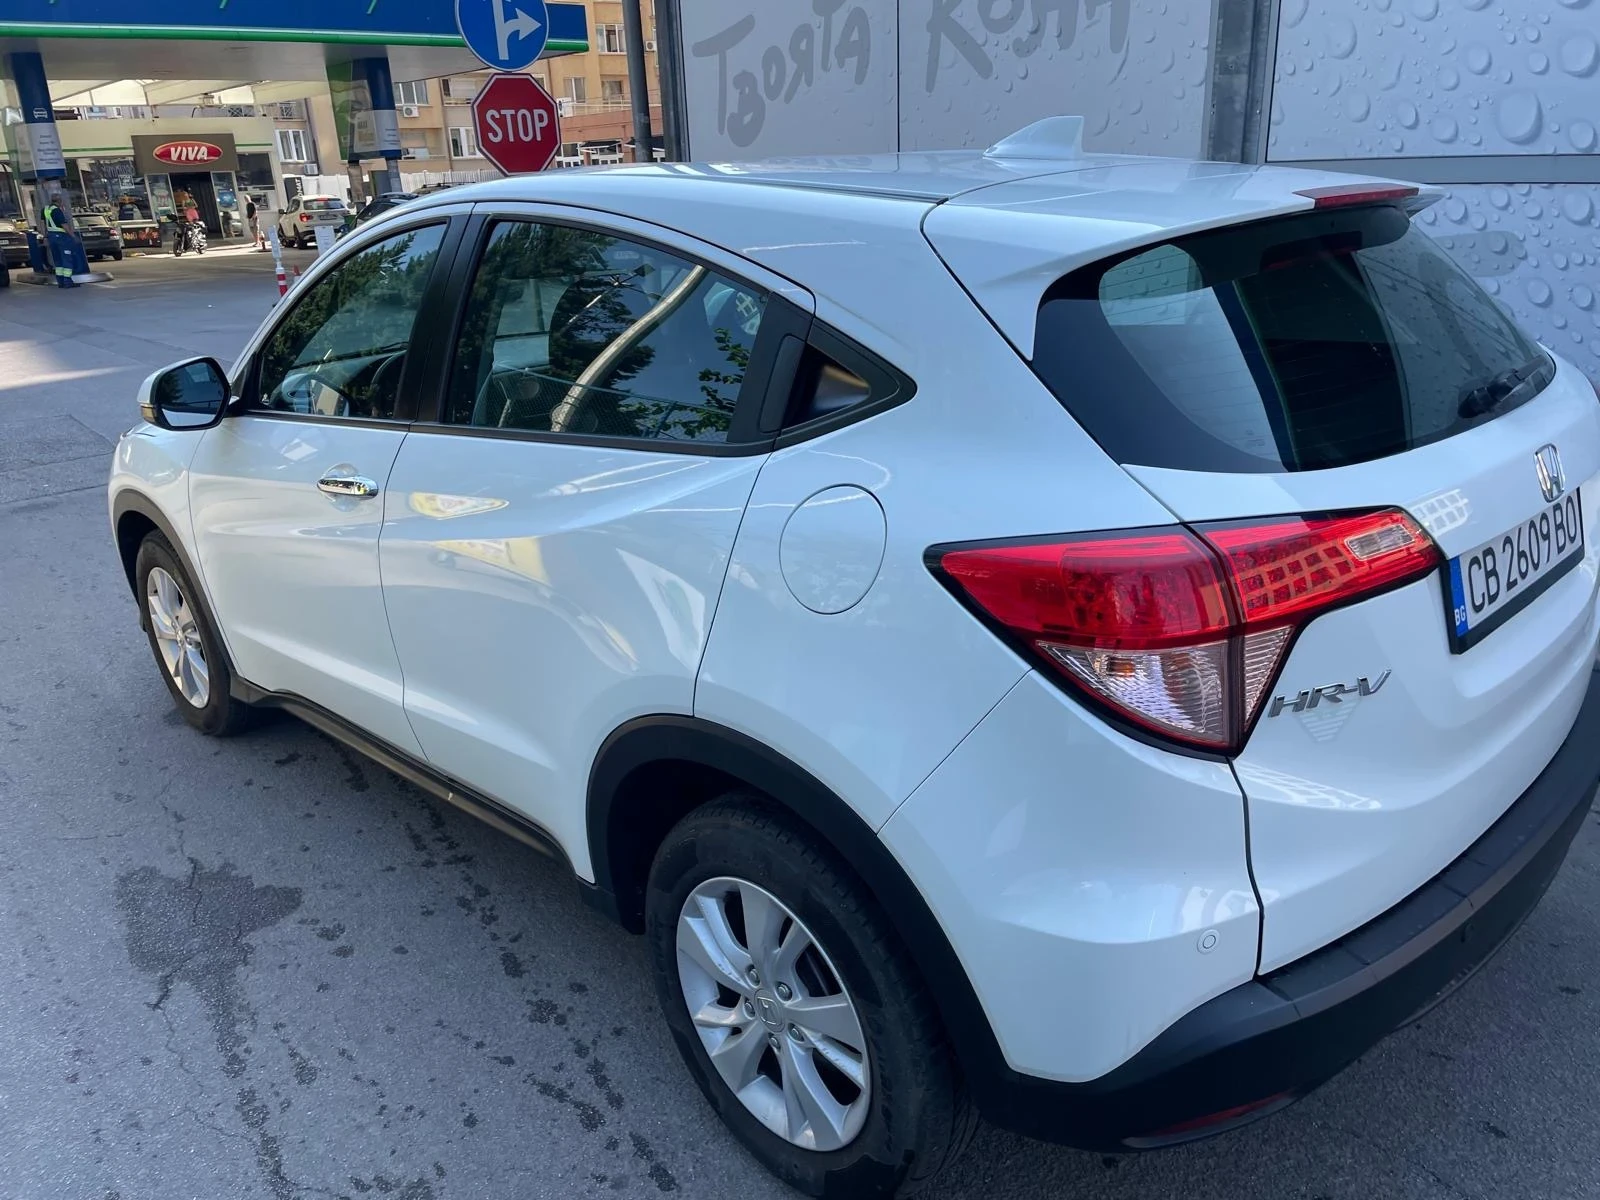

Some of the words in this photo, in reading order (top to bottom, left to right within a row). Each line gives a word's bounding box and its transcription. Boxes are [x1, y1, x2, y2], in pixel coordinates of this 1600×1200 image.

[485, 109, 548, 143] STOP
[170, 146, 208, 161] VIVA
[1468, 546, 1500, 613] CB
[1502, 512, 1550, 592] 2609
[1553, 496, 1577, 555] BO
[1454, 606, 1467, 626] BG
[1267, 669, 1392, 718] HR-V
